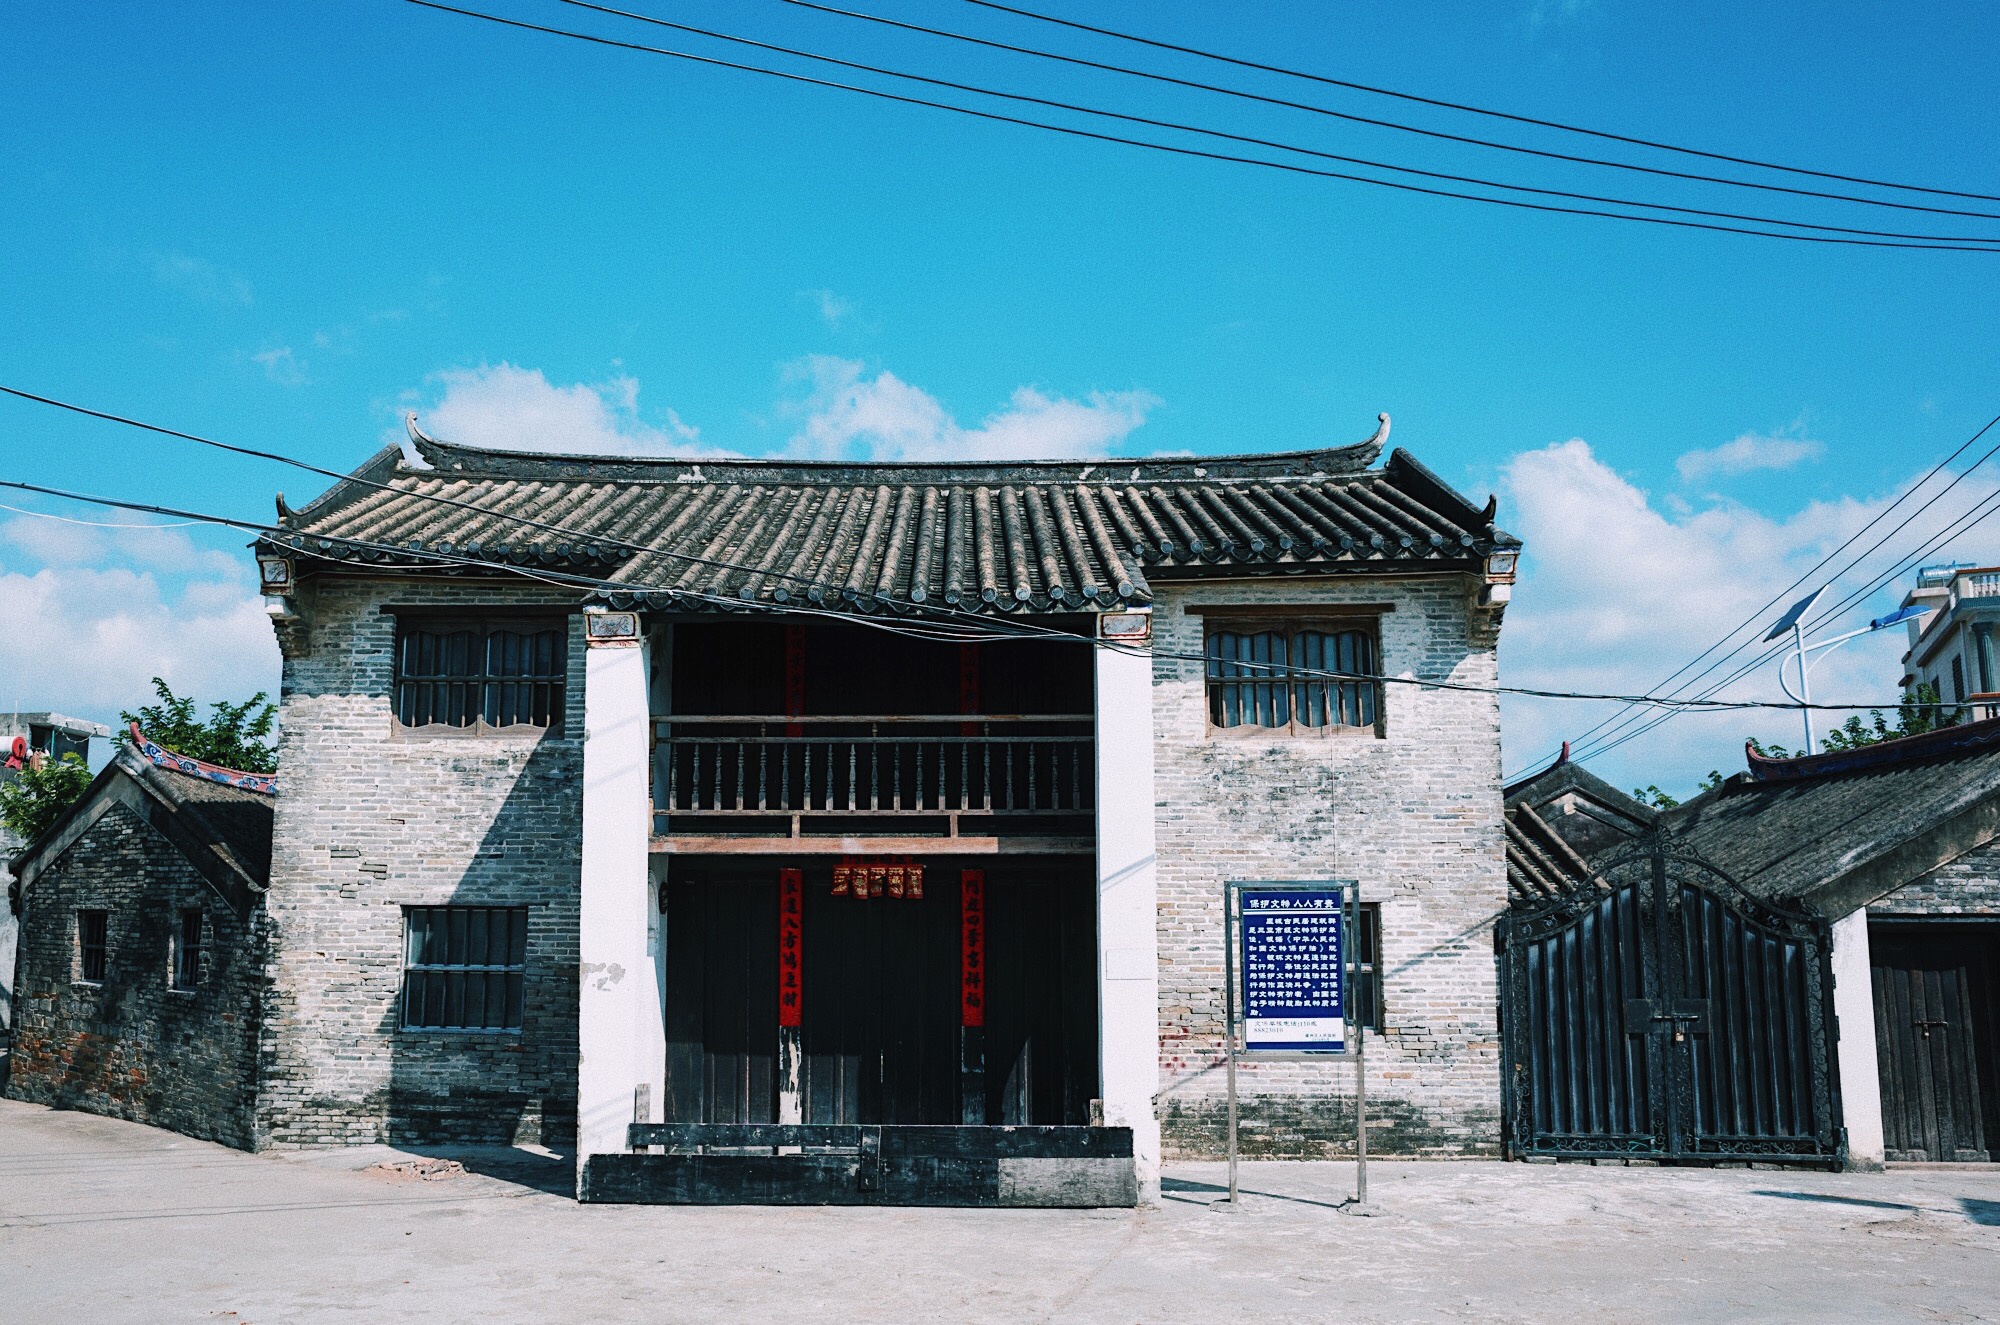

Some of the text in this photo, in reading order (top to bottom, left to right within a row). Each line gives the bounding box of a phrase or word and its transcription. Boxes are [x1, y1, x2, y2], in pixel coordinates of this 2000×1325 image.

[1249, 899, 1334, 909] 保护文物 人人有责
